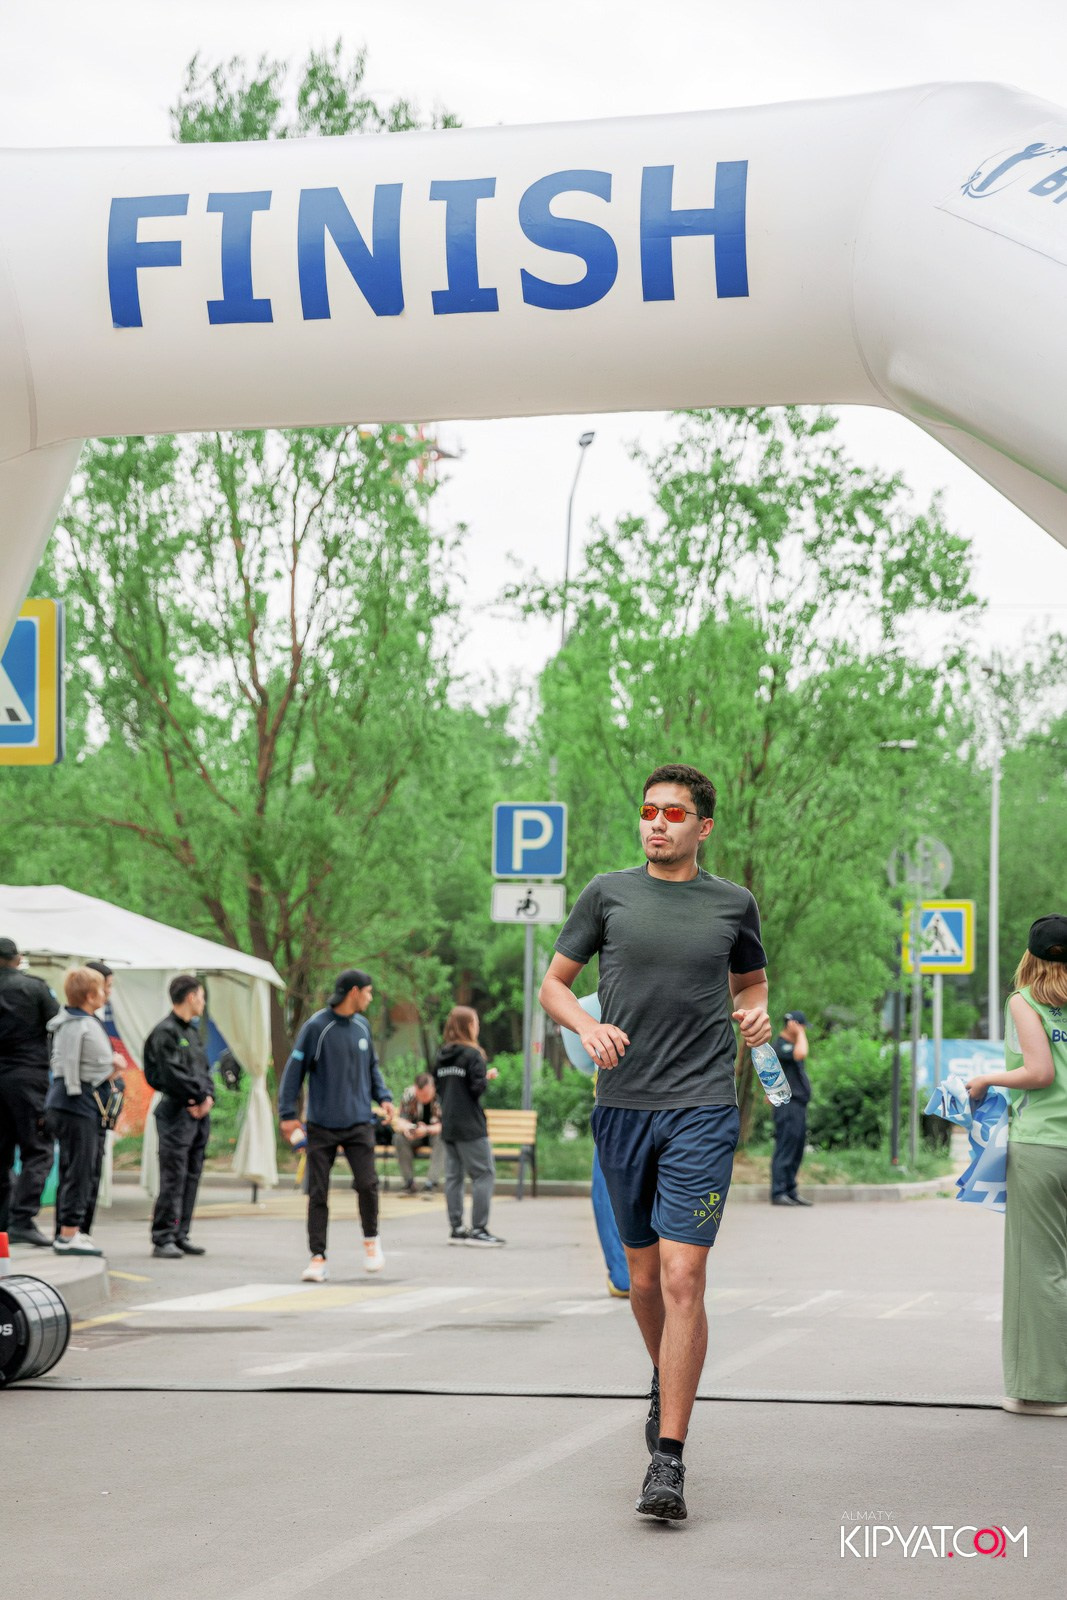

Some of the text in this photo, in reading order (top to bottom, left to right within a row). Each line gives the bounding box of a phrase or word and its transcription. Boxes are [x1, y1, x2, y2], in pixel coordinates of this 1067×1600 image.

[107, 160, 749, 328] FINISH
[512, 809, 554, 872] P
[707, 1192, 721, 1206] P
